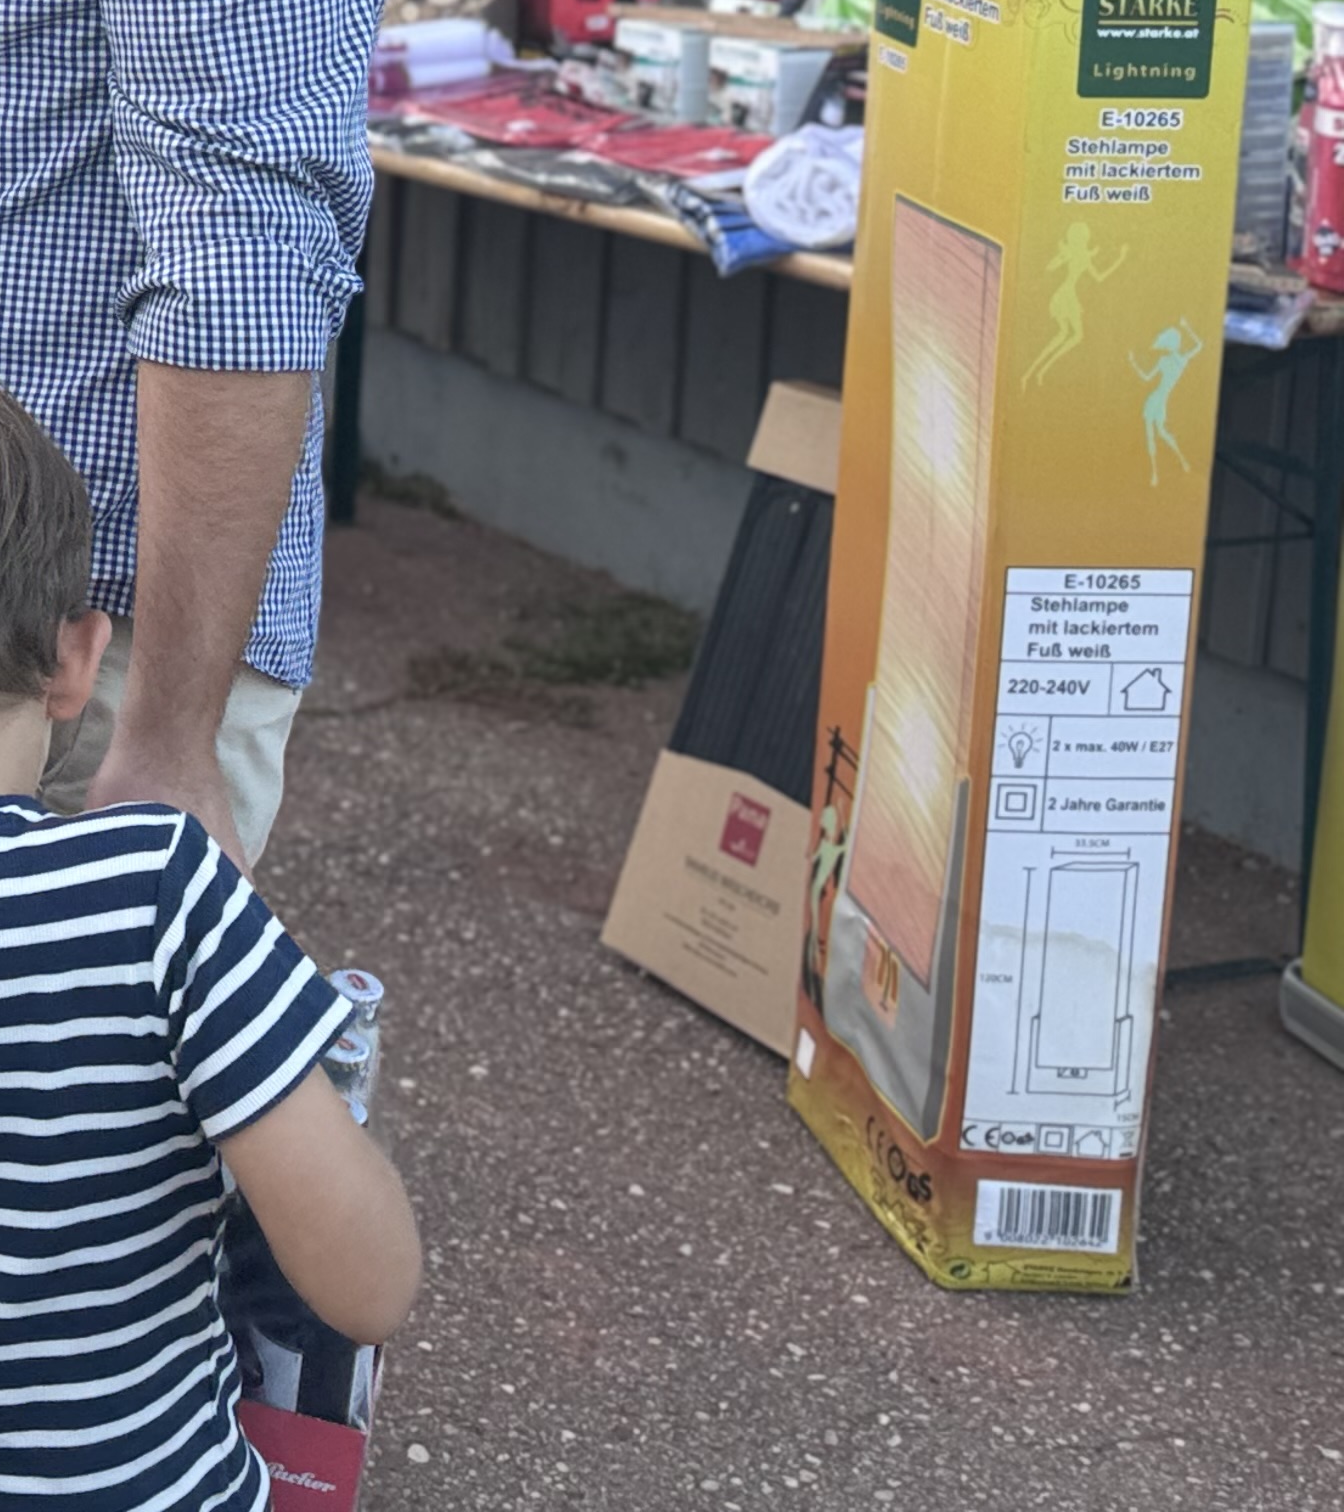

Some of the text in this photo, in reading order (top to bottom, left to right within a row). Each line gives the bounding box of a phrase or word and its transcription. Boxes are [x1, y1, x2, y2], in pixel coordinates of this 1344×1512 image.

[925, 6, 944, 30] Fuß
[1096, 26, 1200, 39] www.starke.at
[1093, 62, 1197, 81] Lightning
[1101, 111, 1181, 128] E-10265
[1067, 139, 1169, 158] Stehlampe
[1065, 163, 1201, 179] mit lackiertem
[1064, 186, 1151, 202] Fuß weiß
[1064, 574, 1141, 590] E-10265
[1030, 597, 1129, 615] Stehlampe
[1028, 619, 1159, 637] mit lackiertem
[1027, 642, 1112, 658] Fuß weiß
[1007, 679, 1091, 695] 220-240V
[1052, 741, 1060, 752] 2
[1064, 744, 1071, 753] x
[1075, 743, 1107, 753] max.
[1110, 741, 1139, 753] 40W
[1150, 741, 1174, 753] E27
[1048, 798, 1166, 812] 2 Jahre Garantie
